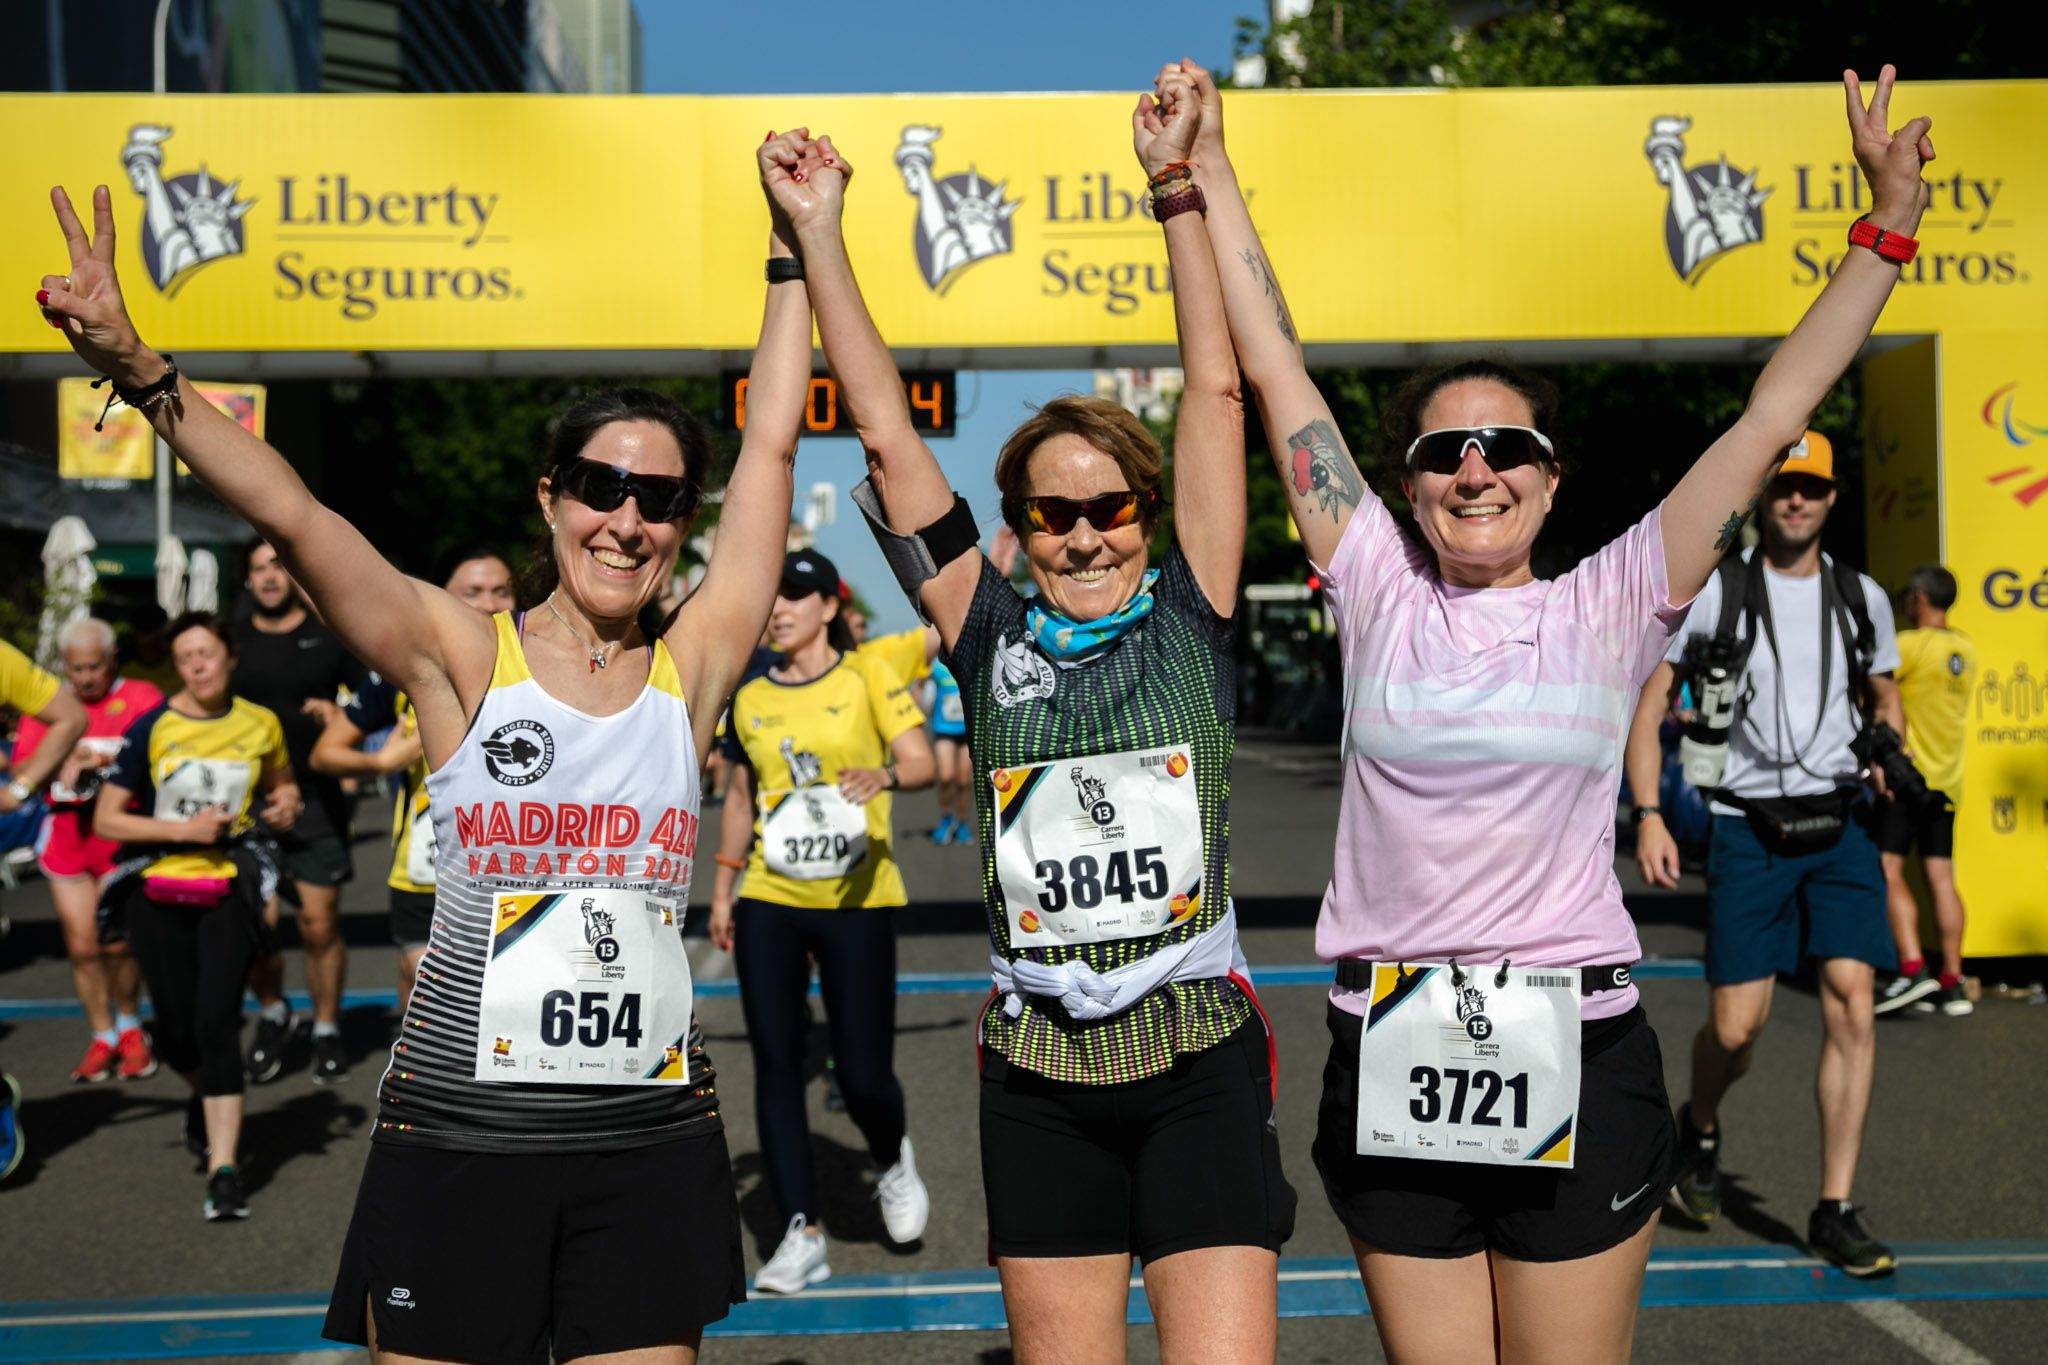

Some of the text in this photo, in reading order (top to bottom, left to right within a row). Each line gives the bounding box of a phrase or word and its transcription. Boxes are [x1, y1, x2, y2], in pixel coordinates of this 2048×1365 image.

[277, 174, 500, 248] Liberty
[497, 720, 554, 785] TIGERS RUNNING CLUB
[1094, 806, 1110, 818] 13
[454, 801, 640, 848] MADRID
[1102, 832, 1125, 840] Liberty
[468, 848, 626, 877] MARATÓN
[643, 854, 689, 885] 2021
[496, 880, 548, 888] MARATHON
[562, 880, 594, 888] AFTER
[1035, 846, 1170, 913] 3845
[599, 944, 615, 957] 13
[602, 964, 625, 972] Carrera
[602, 971, 625, 980] Liberty
[539, 989, 643, 1048] 654
[1471, 1021, 1487, 1035] 13
[1474, 1049, 1500, 1058] Liberty
[1409, 1065, 1528, 1128] 3721
